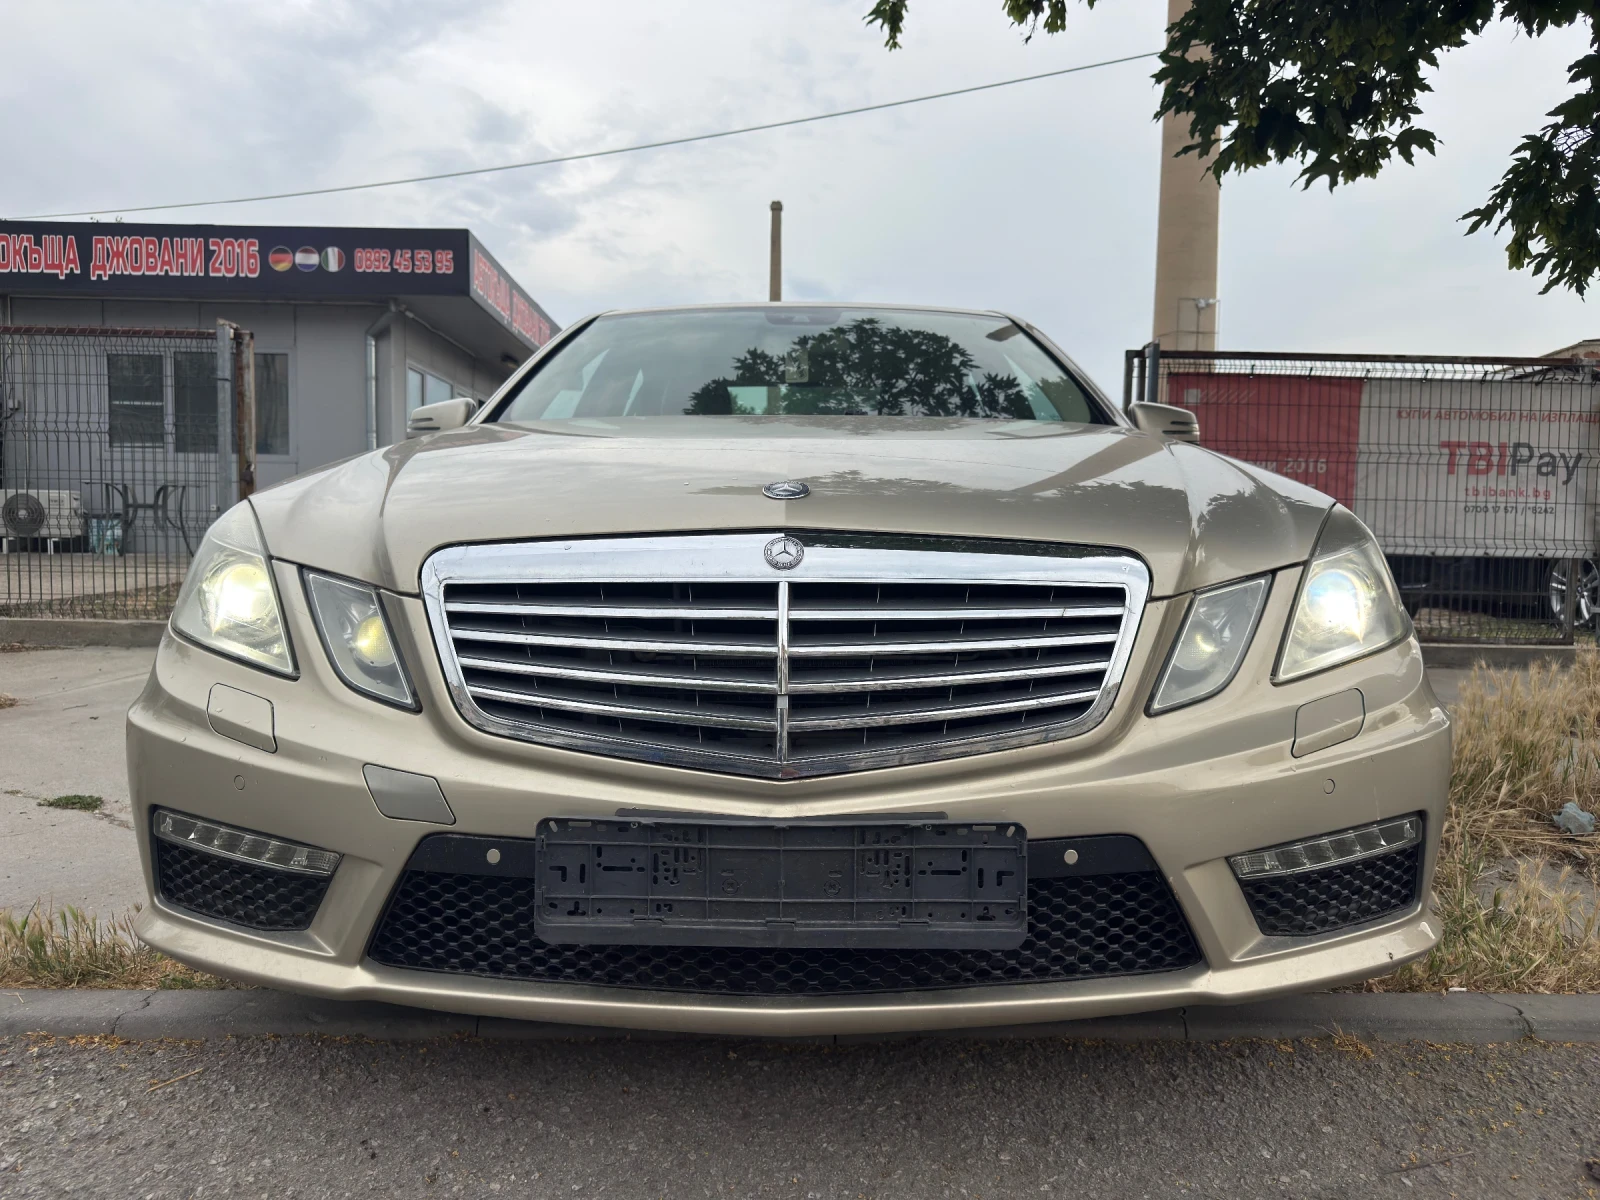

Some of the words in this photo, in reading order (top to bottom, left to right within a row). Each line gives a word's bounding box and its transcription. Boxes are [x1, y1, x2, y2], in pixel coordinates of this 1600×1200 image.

[0, 233, 81, 279] ОКЪЩА
[90, 236, 204, 280] ДЖОВАНИ
[209, 238, 260, 278] 2016
[354, 248, 391, 273] 0892
[393, 249, 412, 273] 45
[414, 250, 432, 273] 53
[435, 250, 454, 274] 95
[1434, 409, 1517, 422] АВТОМОБИЛ
[1519, 411, 1538, 423] НА
[1541, 411, 1600, 425] ИЗПЛАЩ
[1283, 458, 1327, 474] 2016
[1465, 486, 1552, 500] tbibank.bg
[1464, 505, 1489, 514] 0700
[1492, 506, 1501, 514] 17
